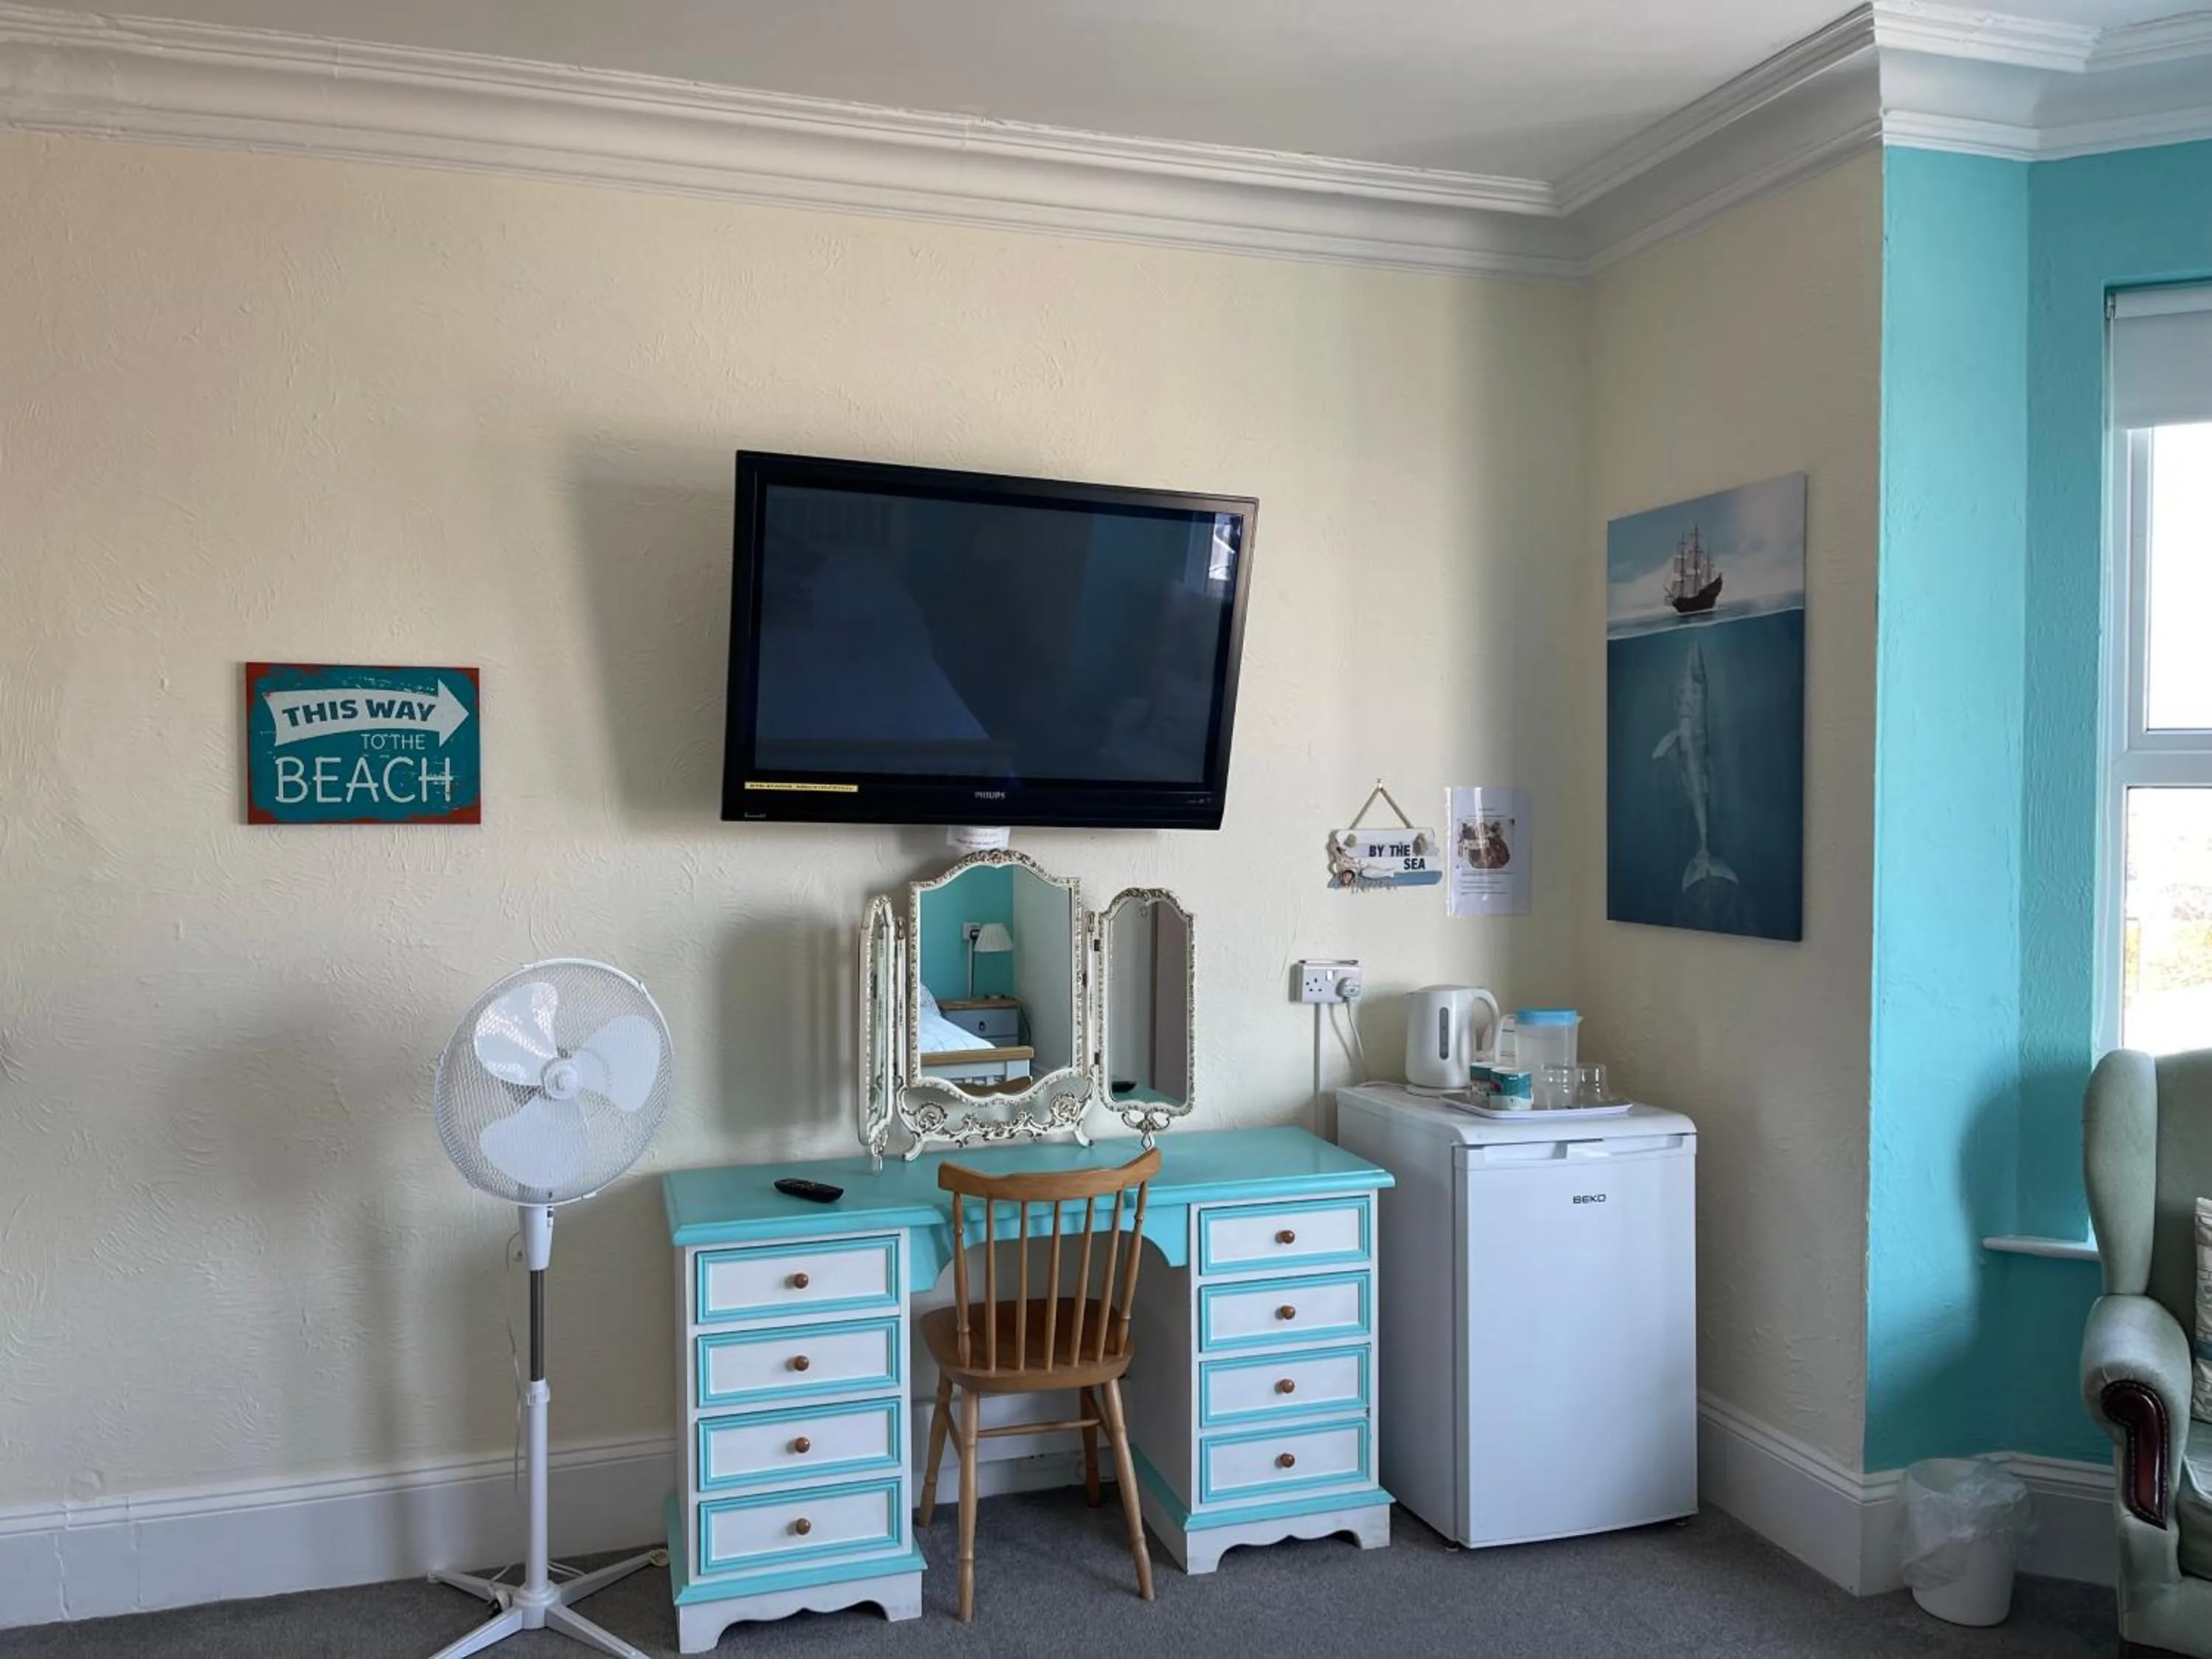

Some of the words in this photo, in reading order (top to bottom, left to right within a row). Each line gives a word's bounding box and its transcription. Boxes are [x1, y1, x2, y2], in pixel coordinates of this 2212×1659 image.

[282, 700, 358, 727] THIS
[365, 699, 437, 722] WAY
[361, 734, 384, 749] TO
[386, 734, 425, 749] THE
[275, 757, 453, 802] BEACH
[1368, 844, 1384, 857] BY
[1389, 844, 1410, 857] THE
[1404, 858, 1425, 870] SEA
[1573, 1194, 1607, 1204] BEKO
